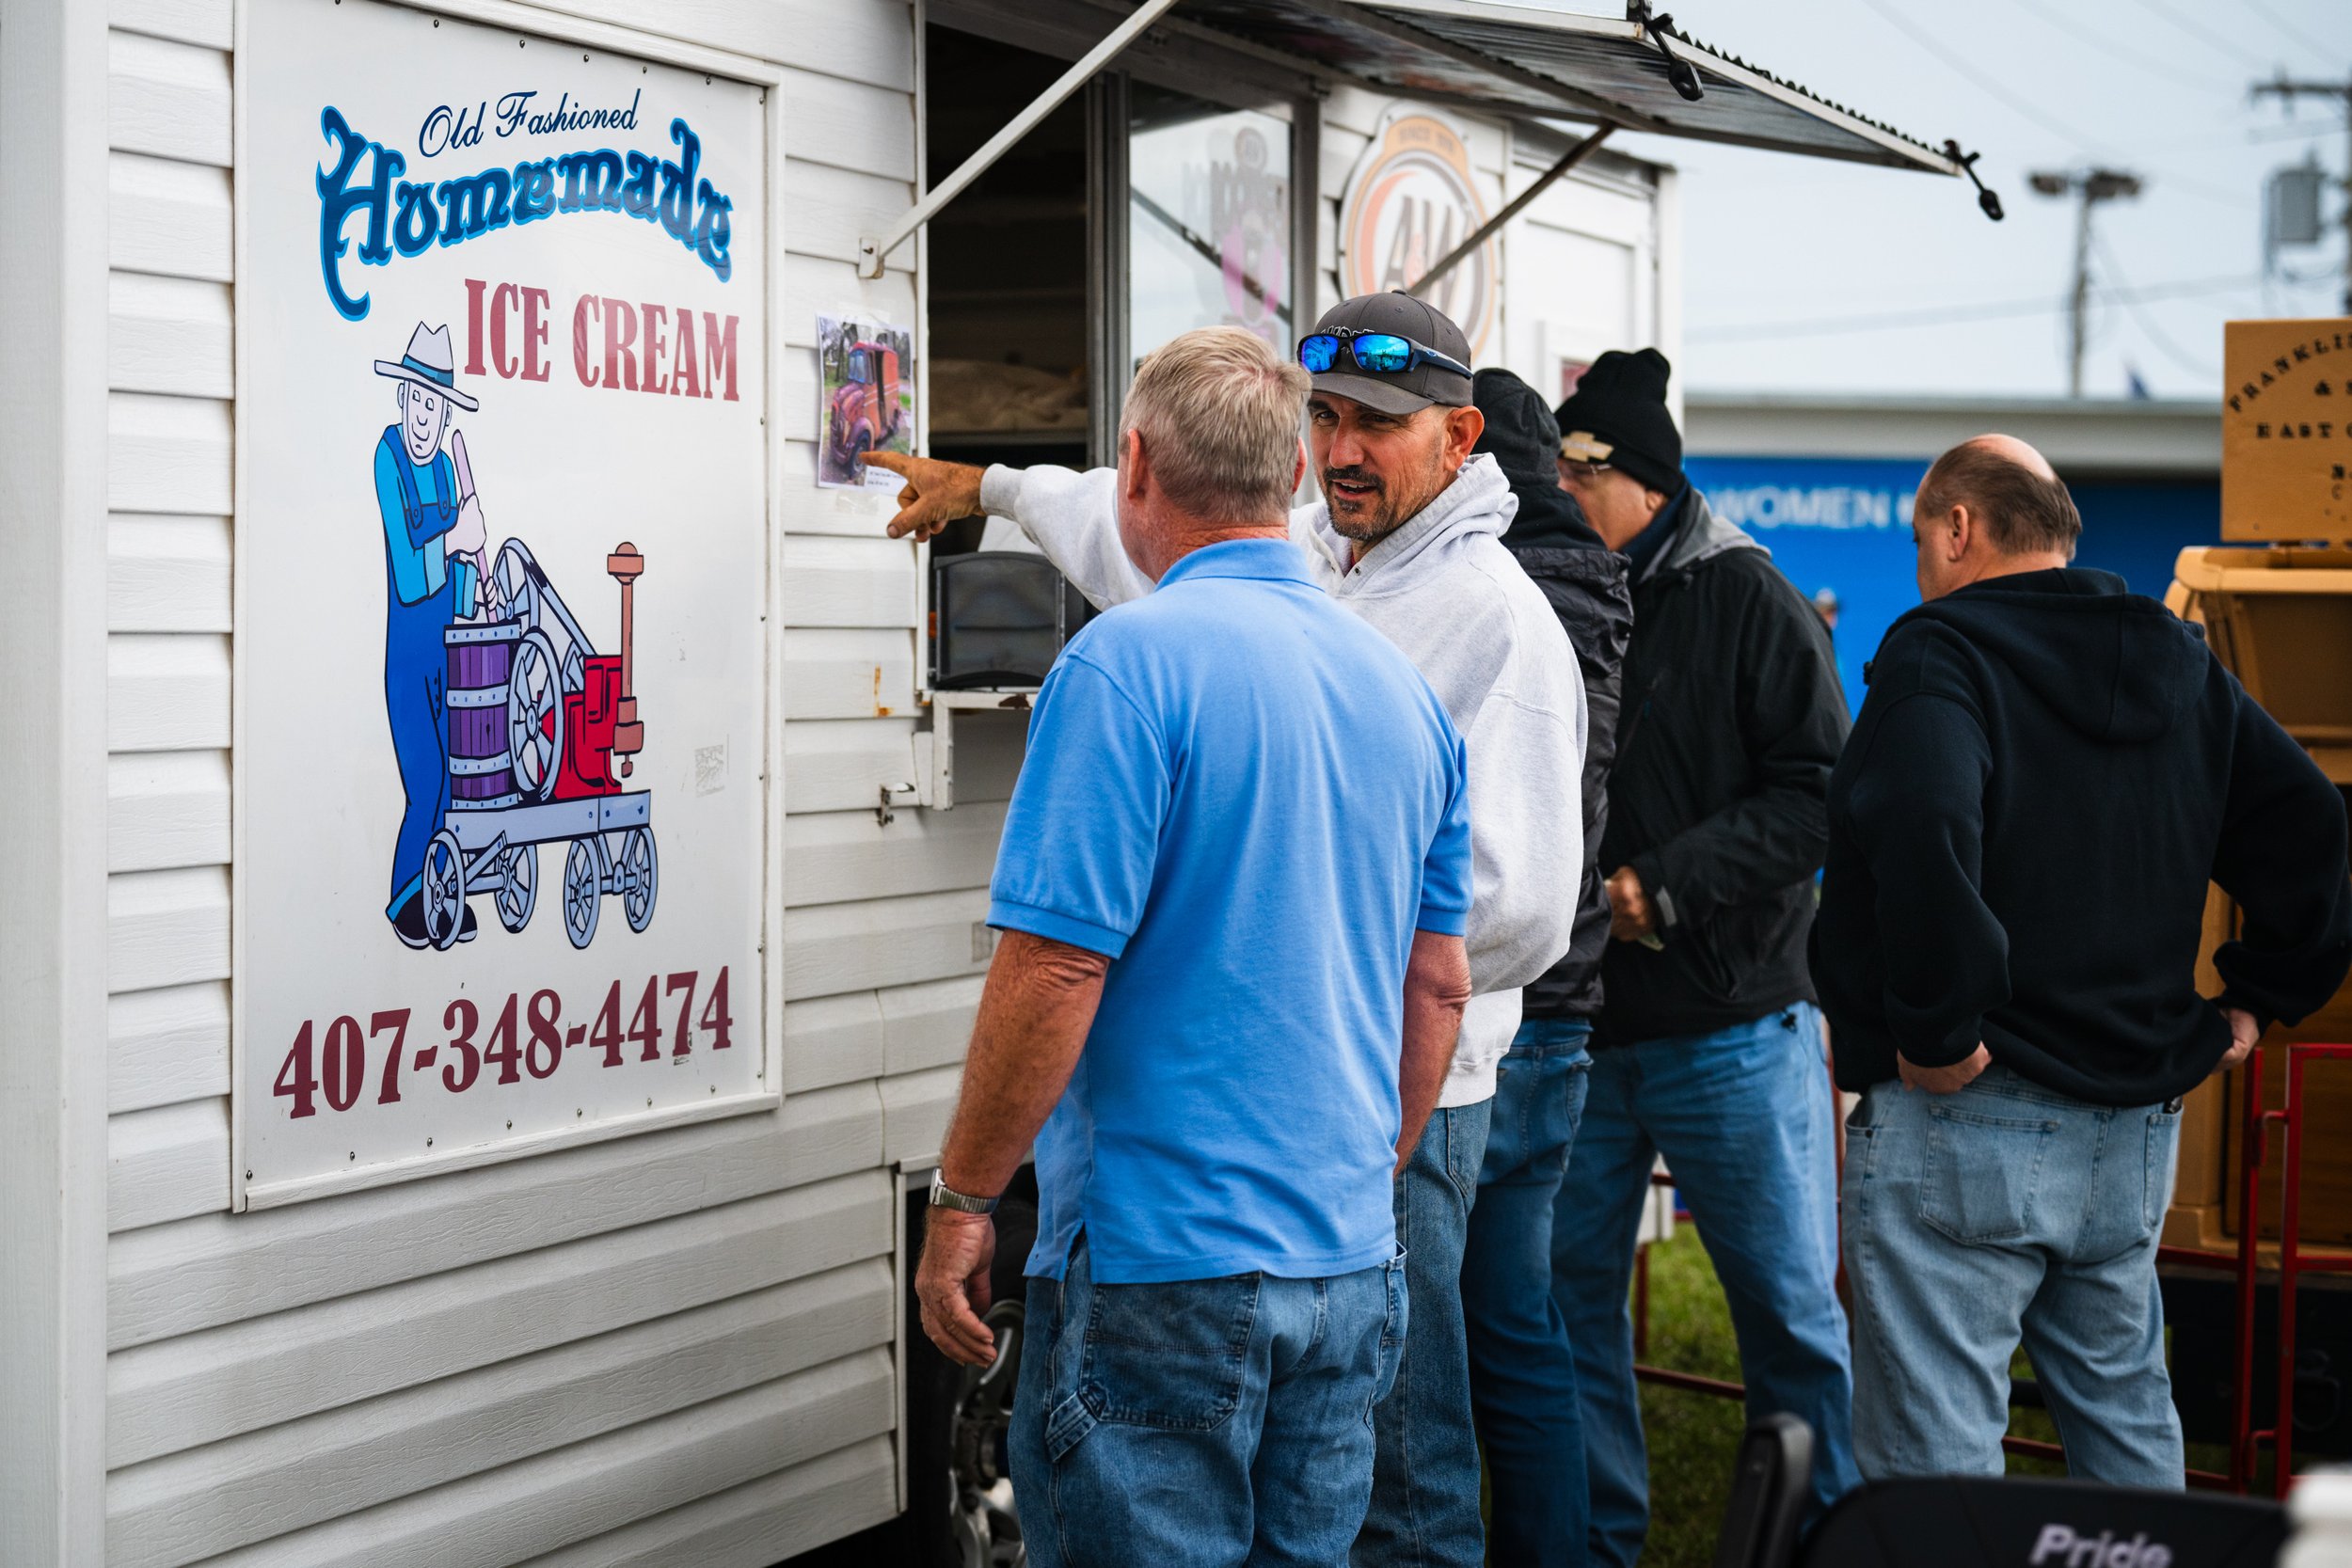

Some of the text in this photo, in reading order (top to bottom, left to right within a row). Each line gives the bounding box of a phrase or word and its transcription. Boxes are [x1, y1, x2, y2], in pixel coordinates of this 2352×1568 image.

[418, 88, 642, 158] Old Fashioned
[315, 104, 736, 323] Homemade
[464, 277, 740, 403] ICE CREAM
[2256, 422, 2332, 438] EAST
[1707, 485, 1891, 530] WOMEN
[272, 965, 734, 1120] 407-348-4474
[2028, 1522, 2173, 1568] Pride
